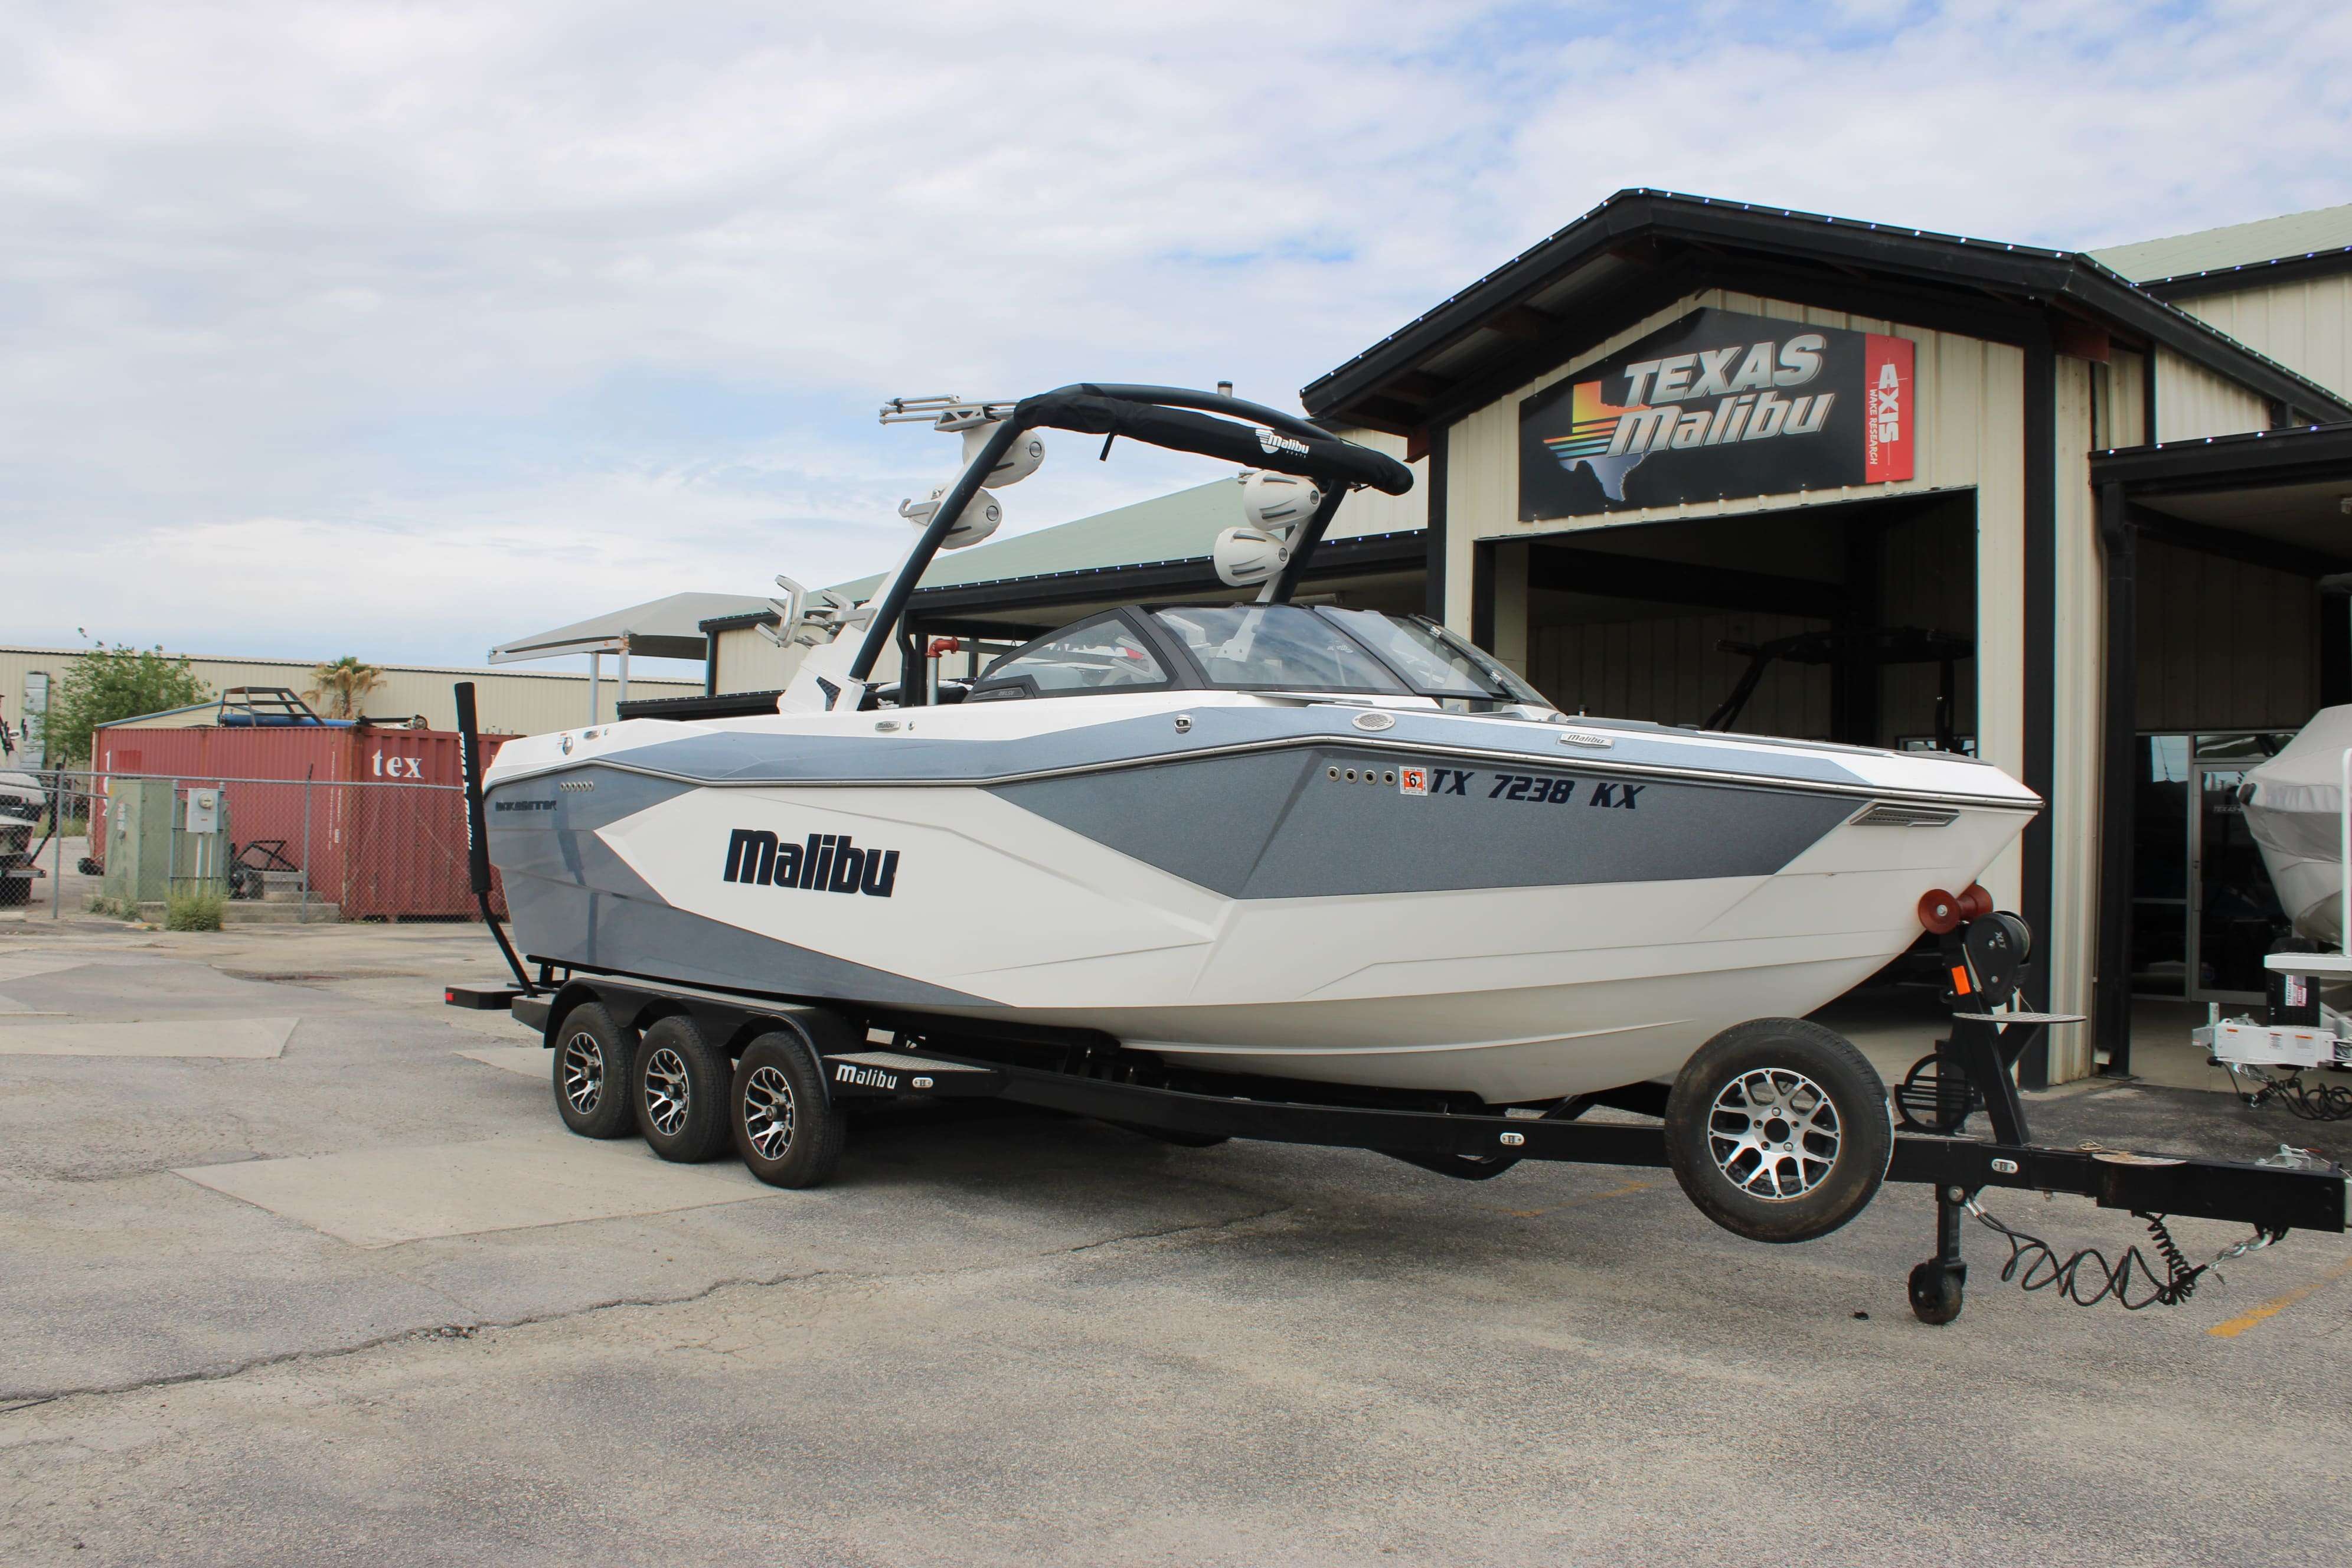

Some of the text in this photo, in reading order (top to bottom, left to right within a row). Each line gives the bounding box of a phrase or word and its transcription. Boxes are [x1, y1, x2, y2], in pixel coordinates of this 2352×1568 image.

[1624, 334, 1827, 407] TEXAS
[1879, 364, 1899, 443] AXIS
[1606, 391, 1835, 458] Malibu
[1869, 389, 1878, 465] WAKE RESEARCH
[1268, 434, 1309, 454] Malibu
[1286, 450, 1306, 458] BOATS
[1567, 734, 1605, 744] Malibu
[372, 749, 424, 779] tex
[1409, 772, 1417, 788] 6
[1430, 769, 1475, 795] TX
[1488, 774, 1575, 804] 7238
[1589, 782, 1646, 809] KX
[723, 828, 900, 897] Malibu
[835, 1064, 897, 1089] Malibu
